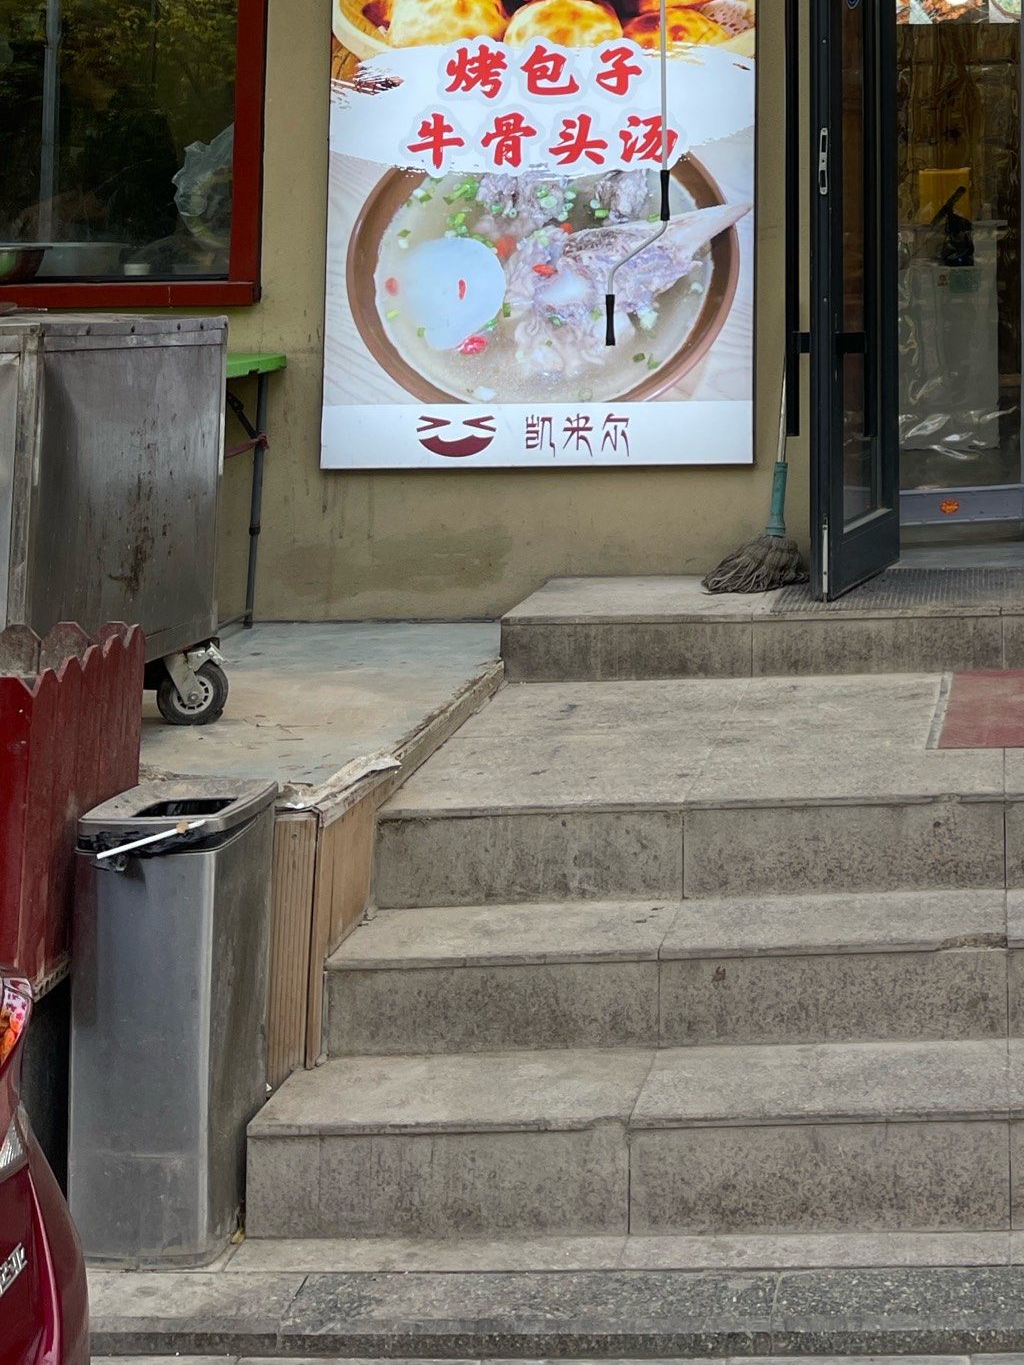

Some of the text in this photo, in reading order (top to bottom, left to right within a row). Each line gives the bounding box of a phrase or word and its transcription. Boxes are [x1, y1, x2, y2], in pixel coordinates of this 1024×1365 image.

[444, 43, 643, 99] 烤包子
[406, 111, 679, 170] 牛骨头汤
[525, 412, 631, 458] 凯米尔
